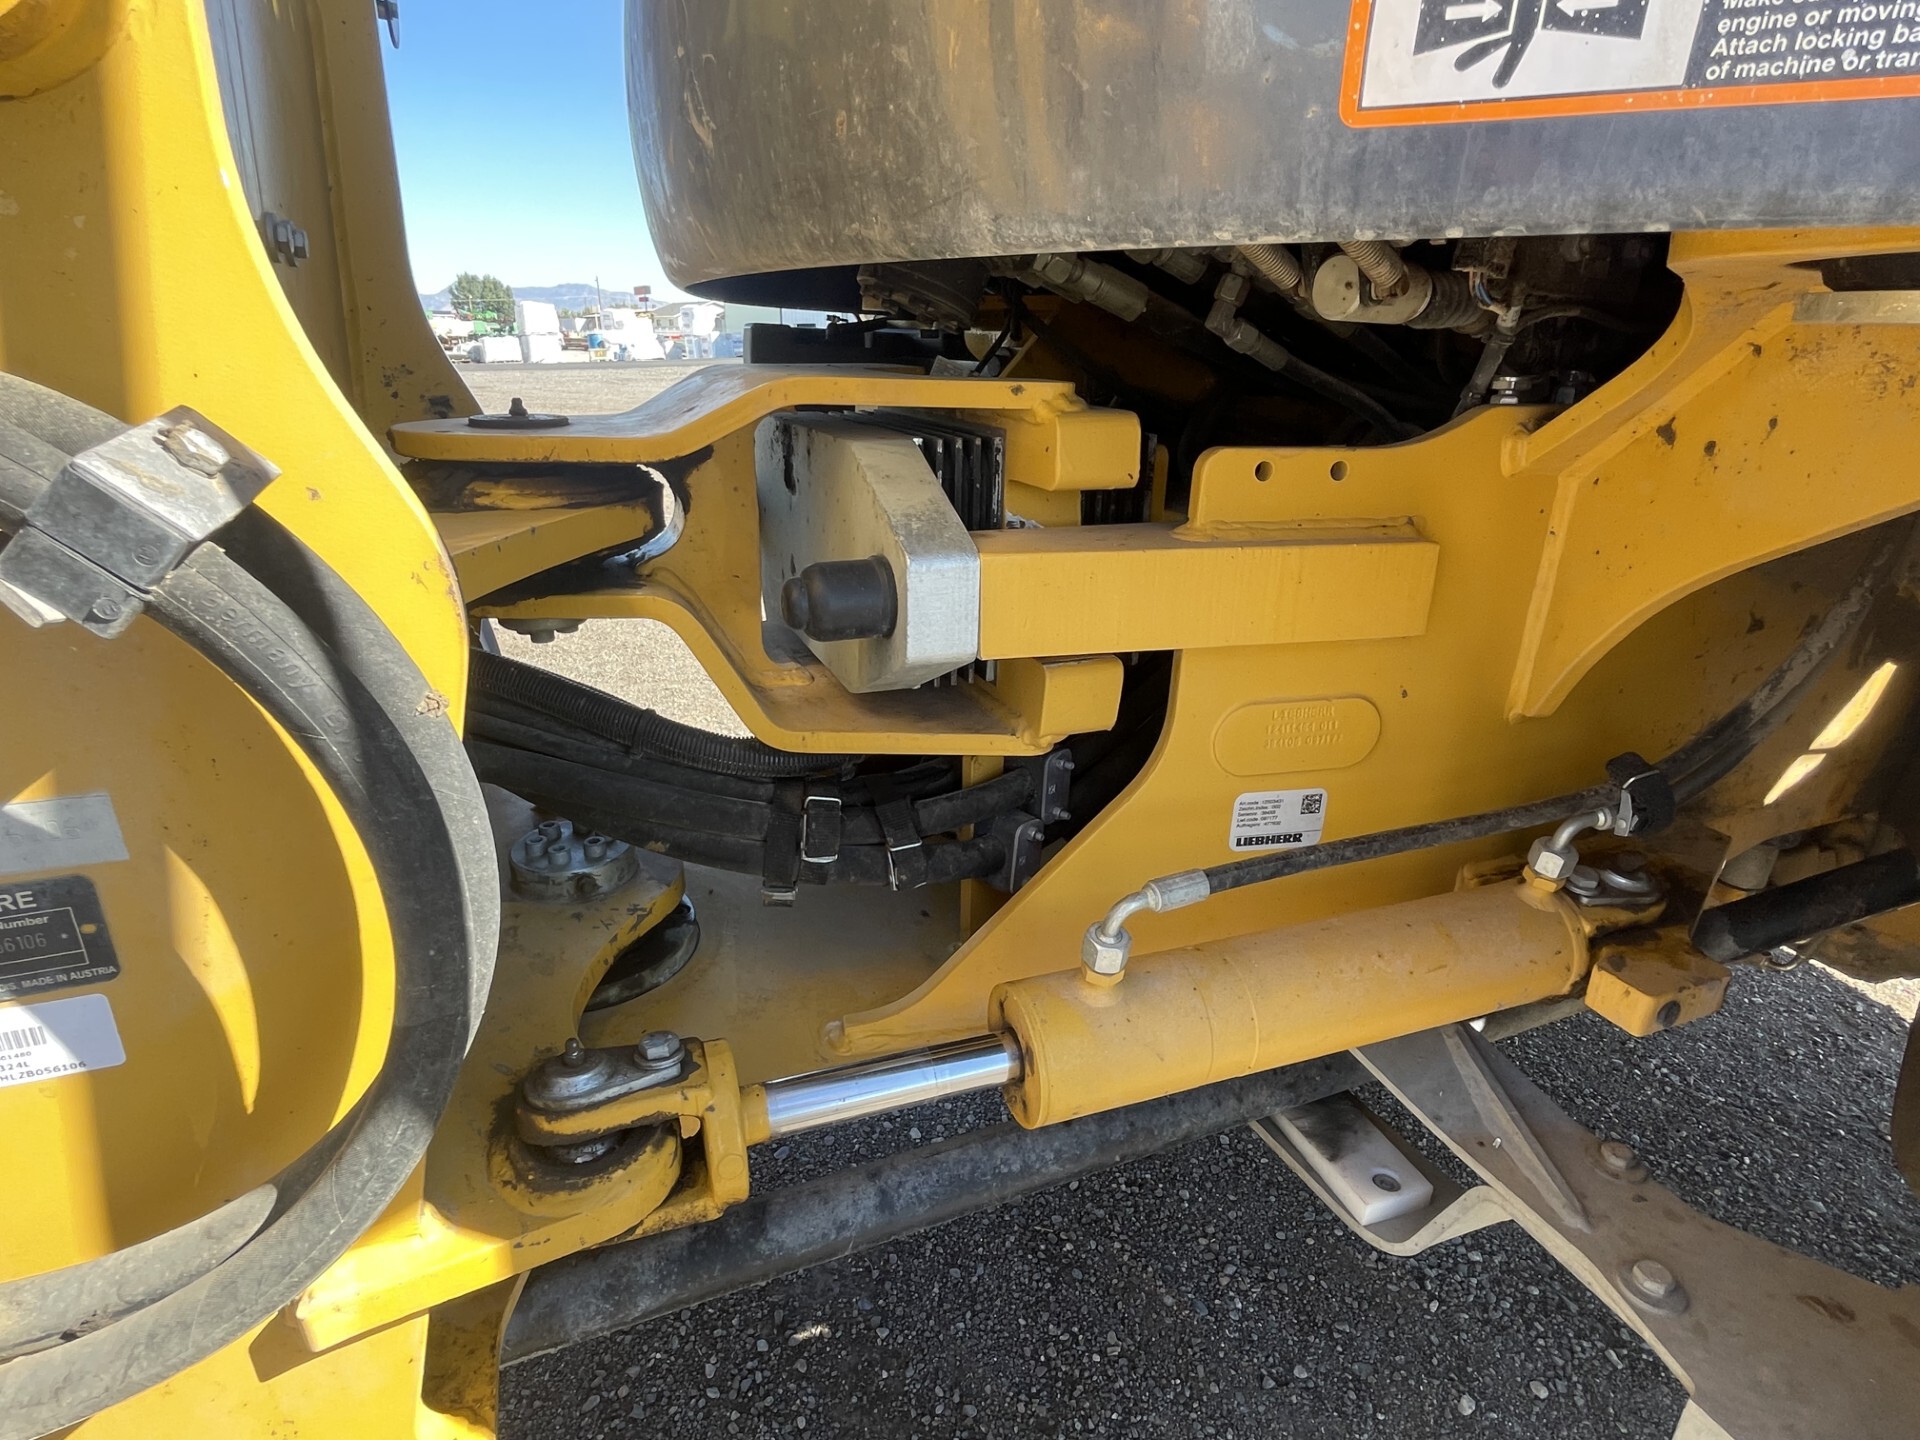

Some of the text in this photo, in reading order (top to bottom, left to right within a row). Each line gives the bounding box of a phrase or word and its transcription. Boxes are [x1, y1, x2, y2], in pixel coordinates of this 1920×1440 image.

[1717, 11, 1798, 36] engine
[1804, 9, 1833, 27] or
[1710, 33, 1788, 58] Attach
[1795, 28, 1886, 51] locking
[1705, 60, 1731, 81] of
[1734, 56, 1836, 78] machine
[1842, 53, 1871, 72] or
[1235, 832, 1303, 847] LIEBHERR
[0, 891, 37, 912] RE
[21, 976, 54, 988] MADE
[56, 973, 68, 983] IN
[70, 965, 117, 980] AUSTRIA
